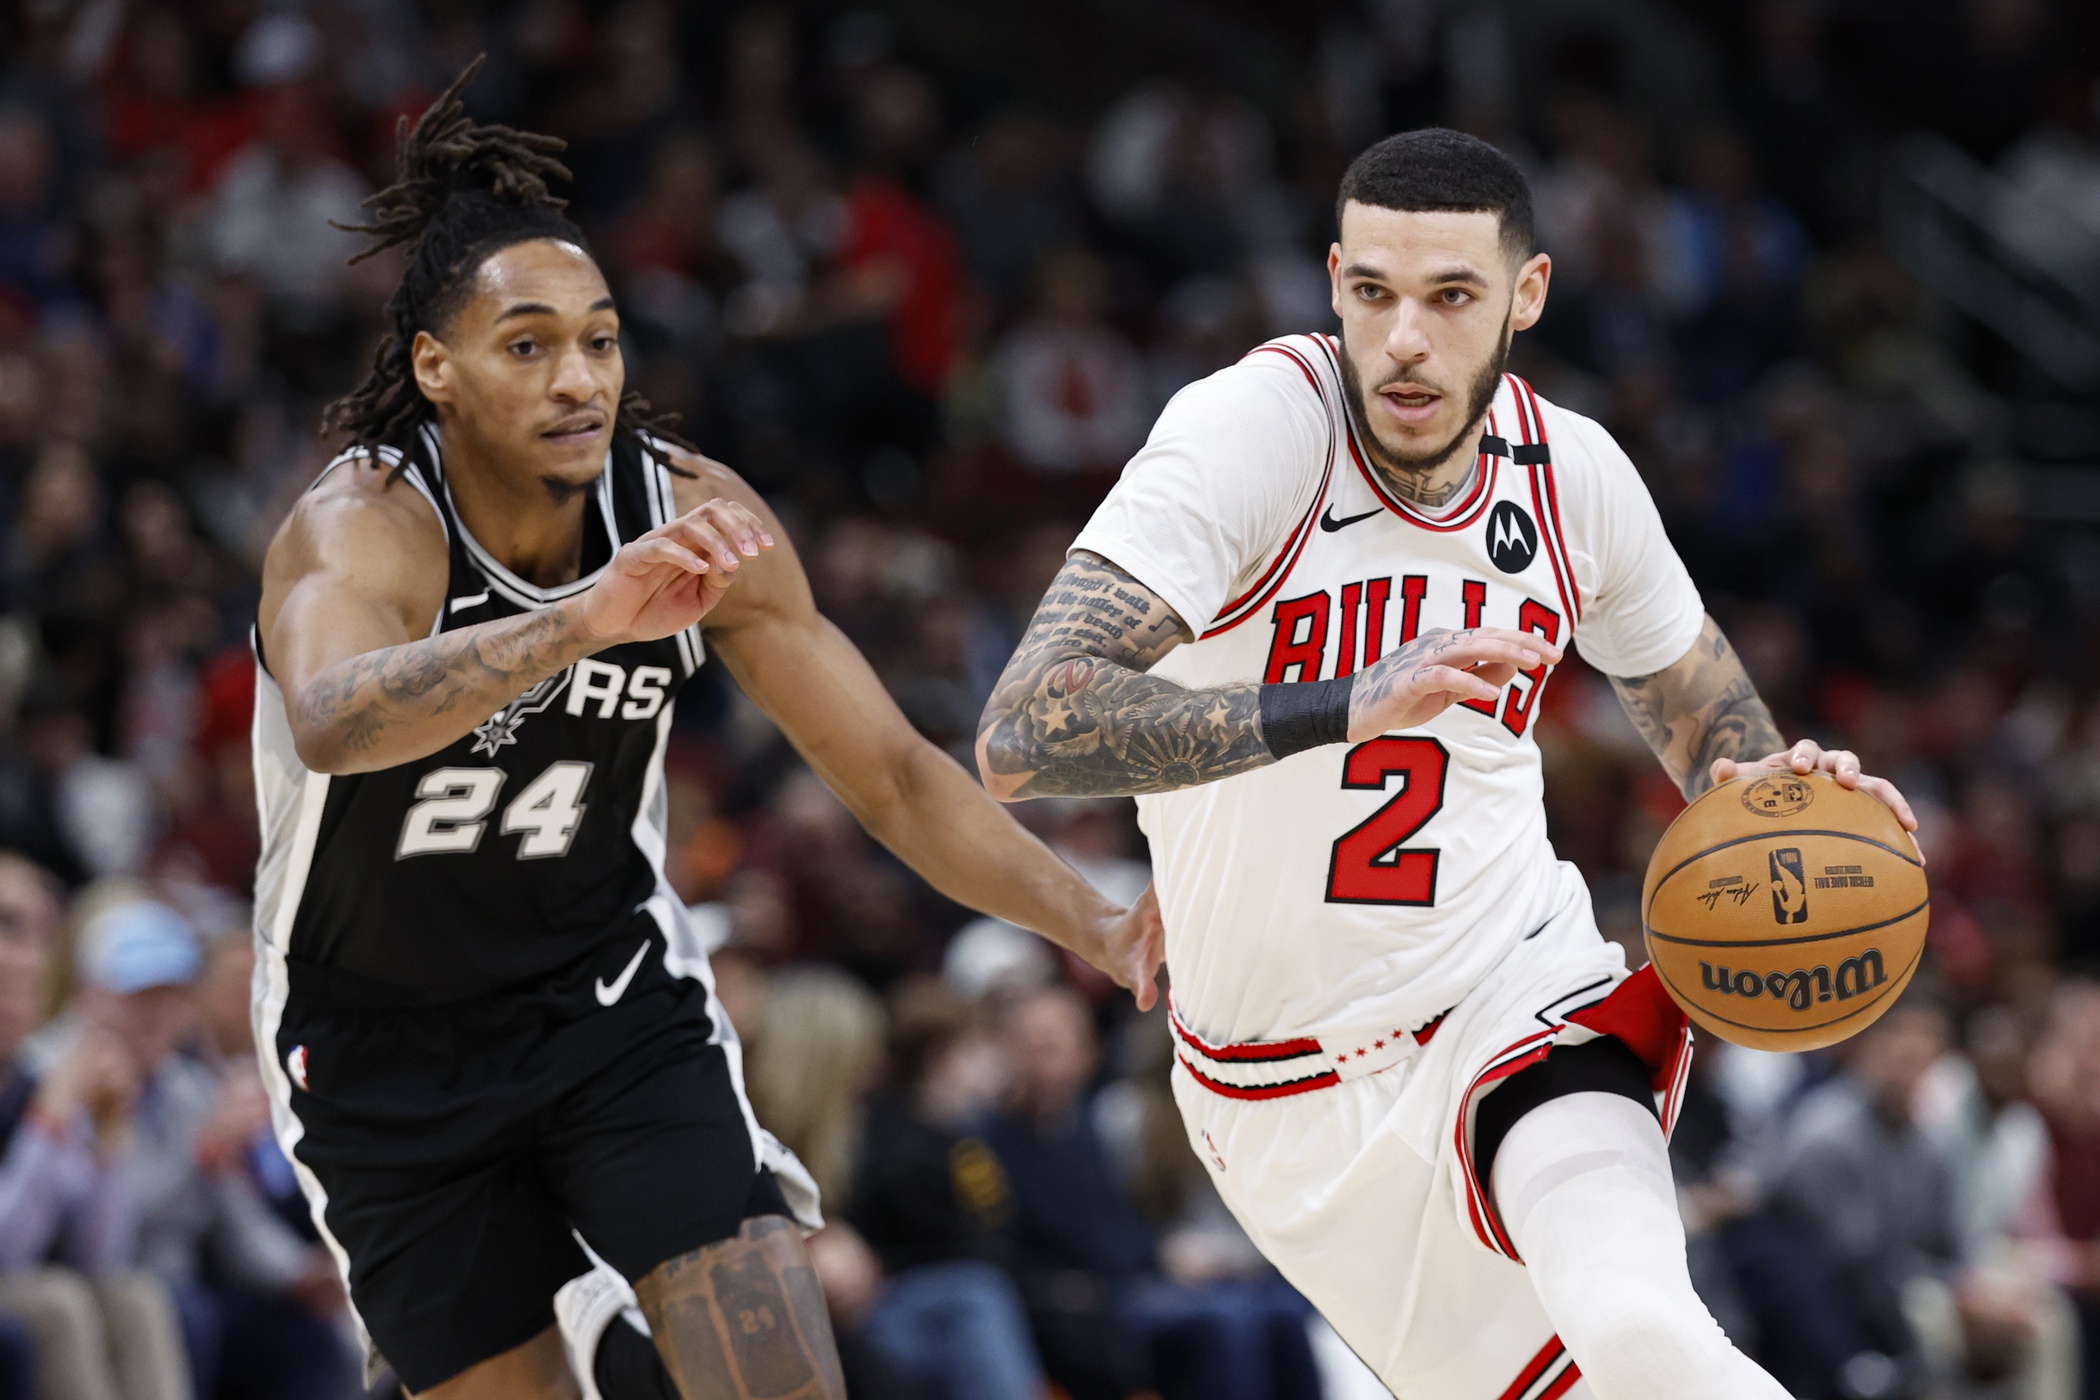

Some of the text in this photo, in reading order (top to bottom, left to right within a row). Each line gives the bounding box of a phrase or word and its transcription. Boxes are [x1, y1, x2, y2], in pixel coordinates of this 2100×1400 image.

[394, 760, 596, 863] 24
[1324, 735, 1451, 908] 2
[1698, 948, 1888, 1012] Wilson
